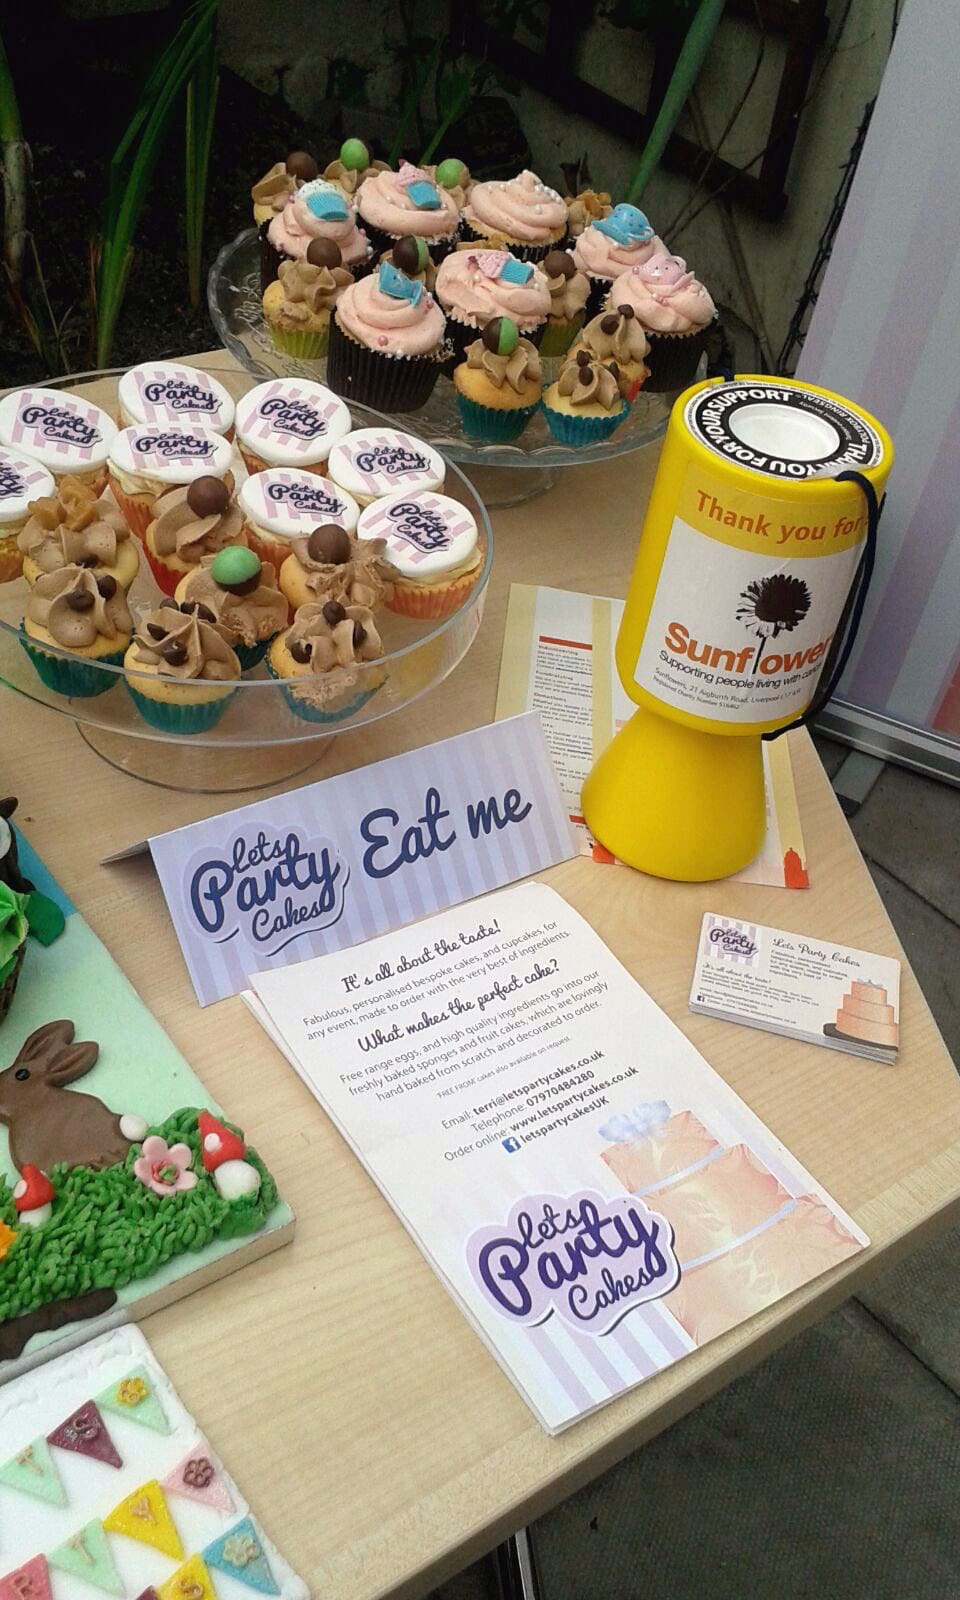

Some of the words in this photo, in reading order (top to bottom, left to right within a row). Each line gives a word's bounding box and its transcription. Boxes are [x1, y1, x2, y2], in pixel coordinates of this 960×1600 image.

[260, 398, 326, 437] Party
[701, 409, 731, 444] YOUR
[707, 389, 793, 413] SUPPORT
[722, 441, 768, 467] FOR
[768, 460, 816, 476] YOU
[697, 490, 771, 537] Thank
[776, 523, 826, 544] you
[833, 516, 863, 538] for
[659, 649, 715, 684] Supporting
[715, 674, 755, 689] people
[756, 679, 781, 690] living
[689, 685, 698, 693] 21
[232, 832, 286, 873] lets
[360, 787, 457, 879] Eat
[467, 789, 532, 839] me
[190, 833, 341, 932] Party
[252, 897, 322, 942] Cakes
[302, 1005, 352, 1026] Fabulous,
[353, 982, 413, 1012] personalised
[413, 966, 453, 988] bespoke
[454, 955, 482, 971] cakes,
[482, 944, 500, 958] and
[501, 928, 545, 950] cupcakes,
[543, 920, 557, 933] for
[375, 962, 395, 982] all
[396, 948, 435, 973] about
[434, 939, 461, 956] the
[458, 919, 501, 945] taste!
[798, 942, 827, 962] Party
[831, 952, 861, 968] Cakes
[307, 1029, 325, 1041] any
[327, 1017, 358, 1034] event,
[359, 1006, 386, 1022] made
[387, 1003, 399, 1012] to
[399, 991, 426, 1007] order
[427, 982, 448, 997] with
[449, 974, 466, 987] the
[466, 966, 487, 980] very
[487, 956, 508, 971] best
[508, 950, 520, 962] of
[357, 1024, 404, 1052] What
[405, 1011, 450, 1035] makes
[447, 997, 476, 1016] the
[477, 974, 523, 1011] perfect
[524, 958, 560, 985] cake?
[339, 1071, 363, 1084] Free
[364, 1057, 393, 1073] range
[394, 1048, 422, 1064] eggs,
[422, 1038, 441, 1053] and
[441, 1026, 465, 1045] high
[465, 1014, 498, 1035] quality
[498, 992, 550, 1020] ingredients
[551, 985, 564, 999] go
[564, 976, 582, 991] into
[584, 970, 600, 982] our
[348, 1077, 384, 1096] freshly
[384, 1064, 416, 1082] baked
[416, 1047, 458, 1070] sponges
[459, 1038, 478, 1053] and
[477, 1028, 500, 1045] fruit
[499, 1018, 529, 1034] cakes,
[528, 1005, 557, 1022] which
[558, 997, 572, 1009] are
[572, 980, 609, 1003] lovingly
[376, 1083, 405, 1101] hand
[403, 1071, 436, 1091] baked
[435, 1062, 461, 1078] from
[462, 1046, 496, 1067] scratch
[497, 1037, 515, 1052] and
[516, 1014, 563, 1042] decorated
[563, 1011, 574, 1021] to
[441, 1111, 473, 1130] Email:
[472, 1049, 605, 1117] terri@letspartycakes.co.uk
[444, 1144, 475, 1162] Order
[475, 1128, 511, 1149] online:
[510, 1066, 639, 1132] www.letspartycakes.co.uk
[471, 1102, 529, 1132] Telephone:
[526, 1070, 595, 1107] 07970484280
[520, 1096, 610, 1143] letspartycakesUK
[518, 1204, 582, 1248] lets
[479, 1199, 667, 1316] Party
[568, 1268, 652, 1321] Cakes
